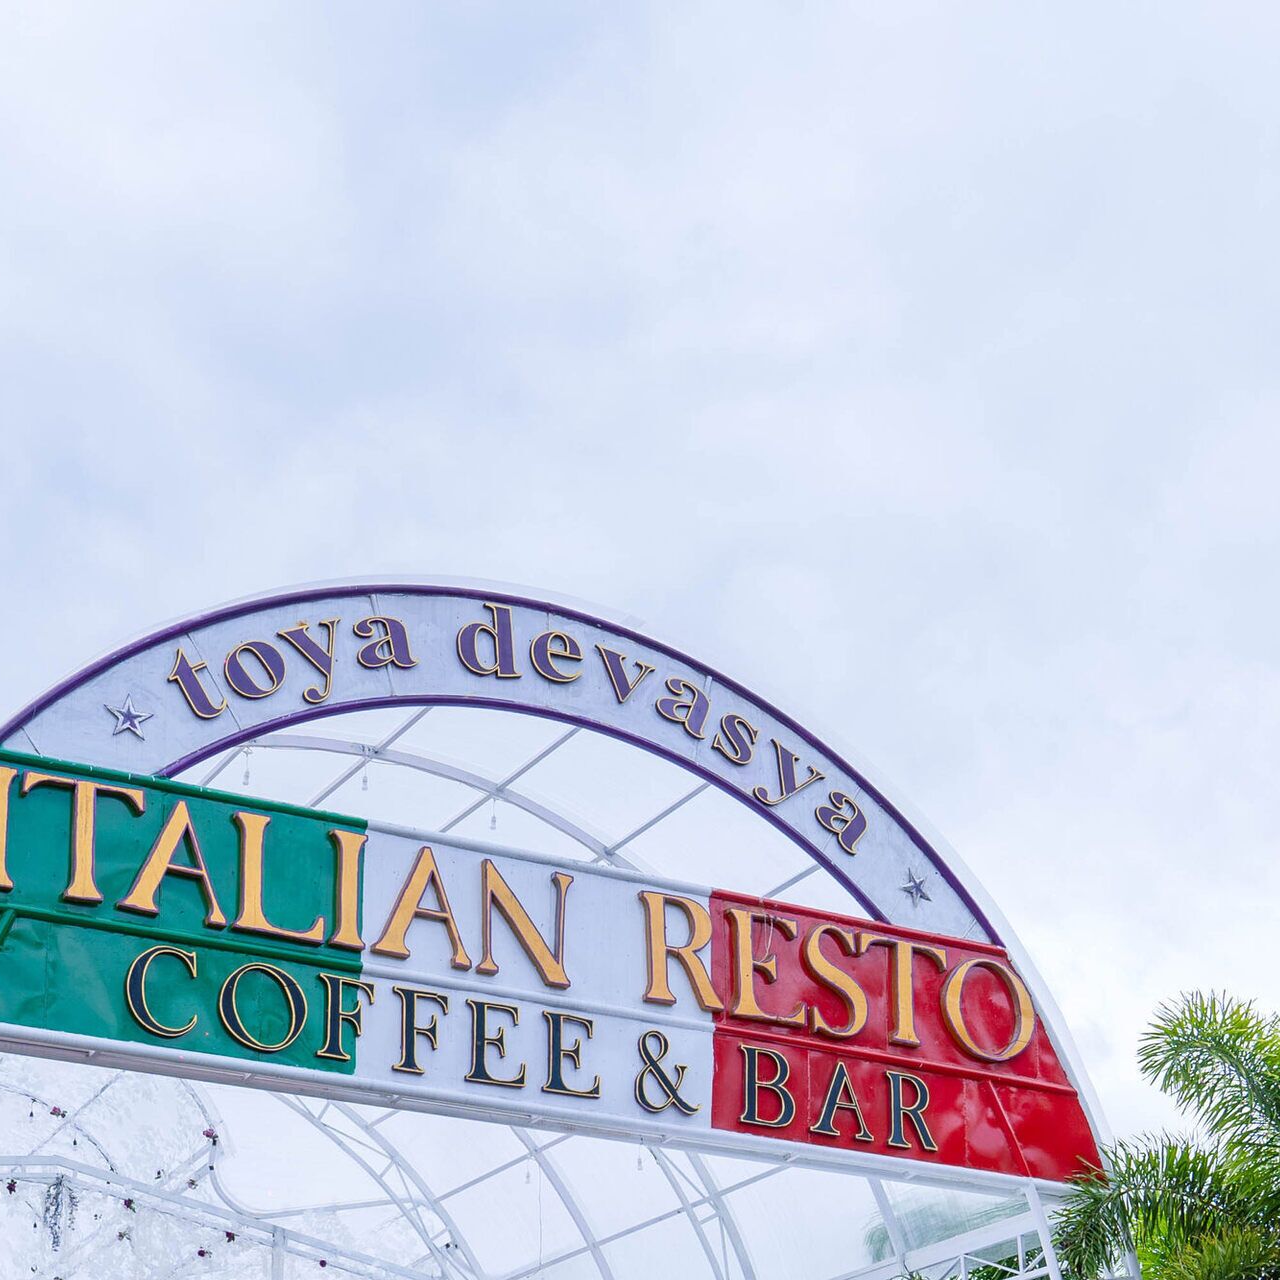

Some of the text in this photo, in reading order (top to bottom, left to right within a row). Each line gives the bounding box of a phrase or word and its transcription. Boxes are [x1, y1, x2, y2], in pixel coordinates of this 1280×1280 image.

[168, 603, 869, 856] toya devasya
[125, 945, 939, 1153] COFFEE & BAR
[639, 890, 1037, 1063] RESTO
